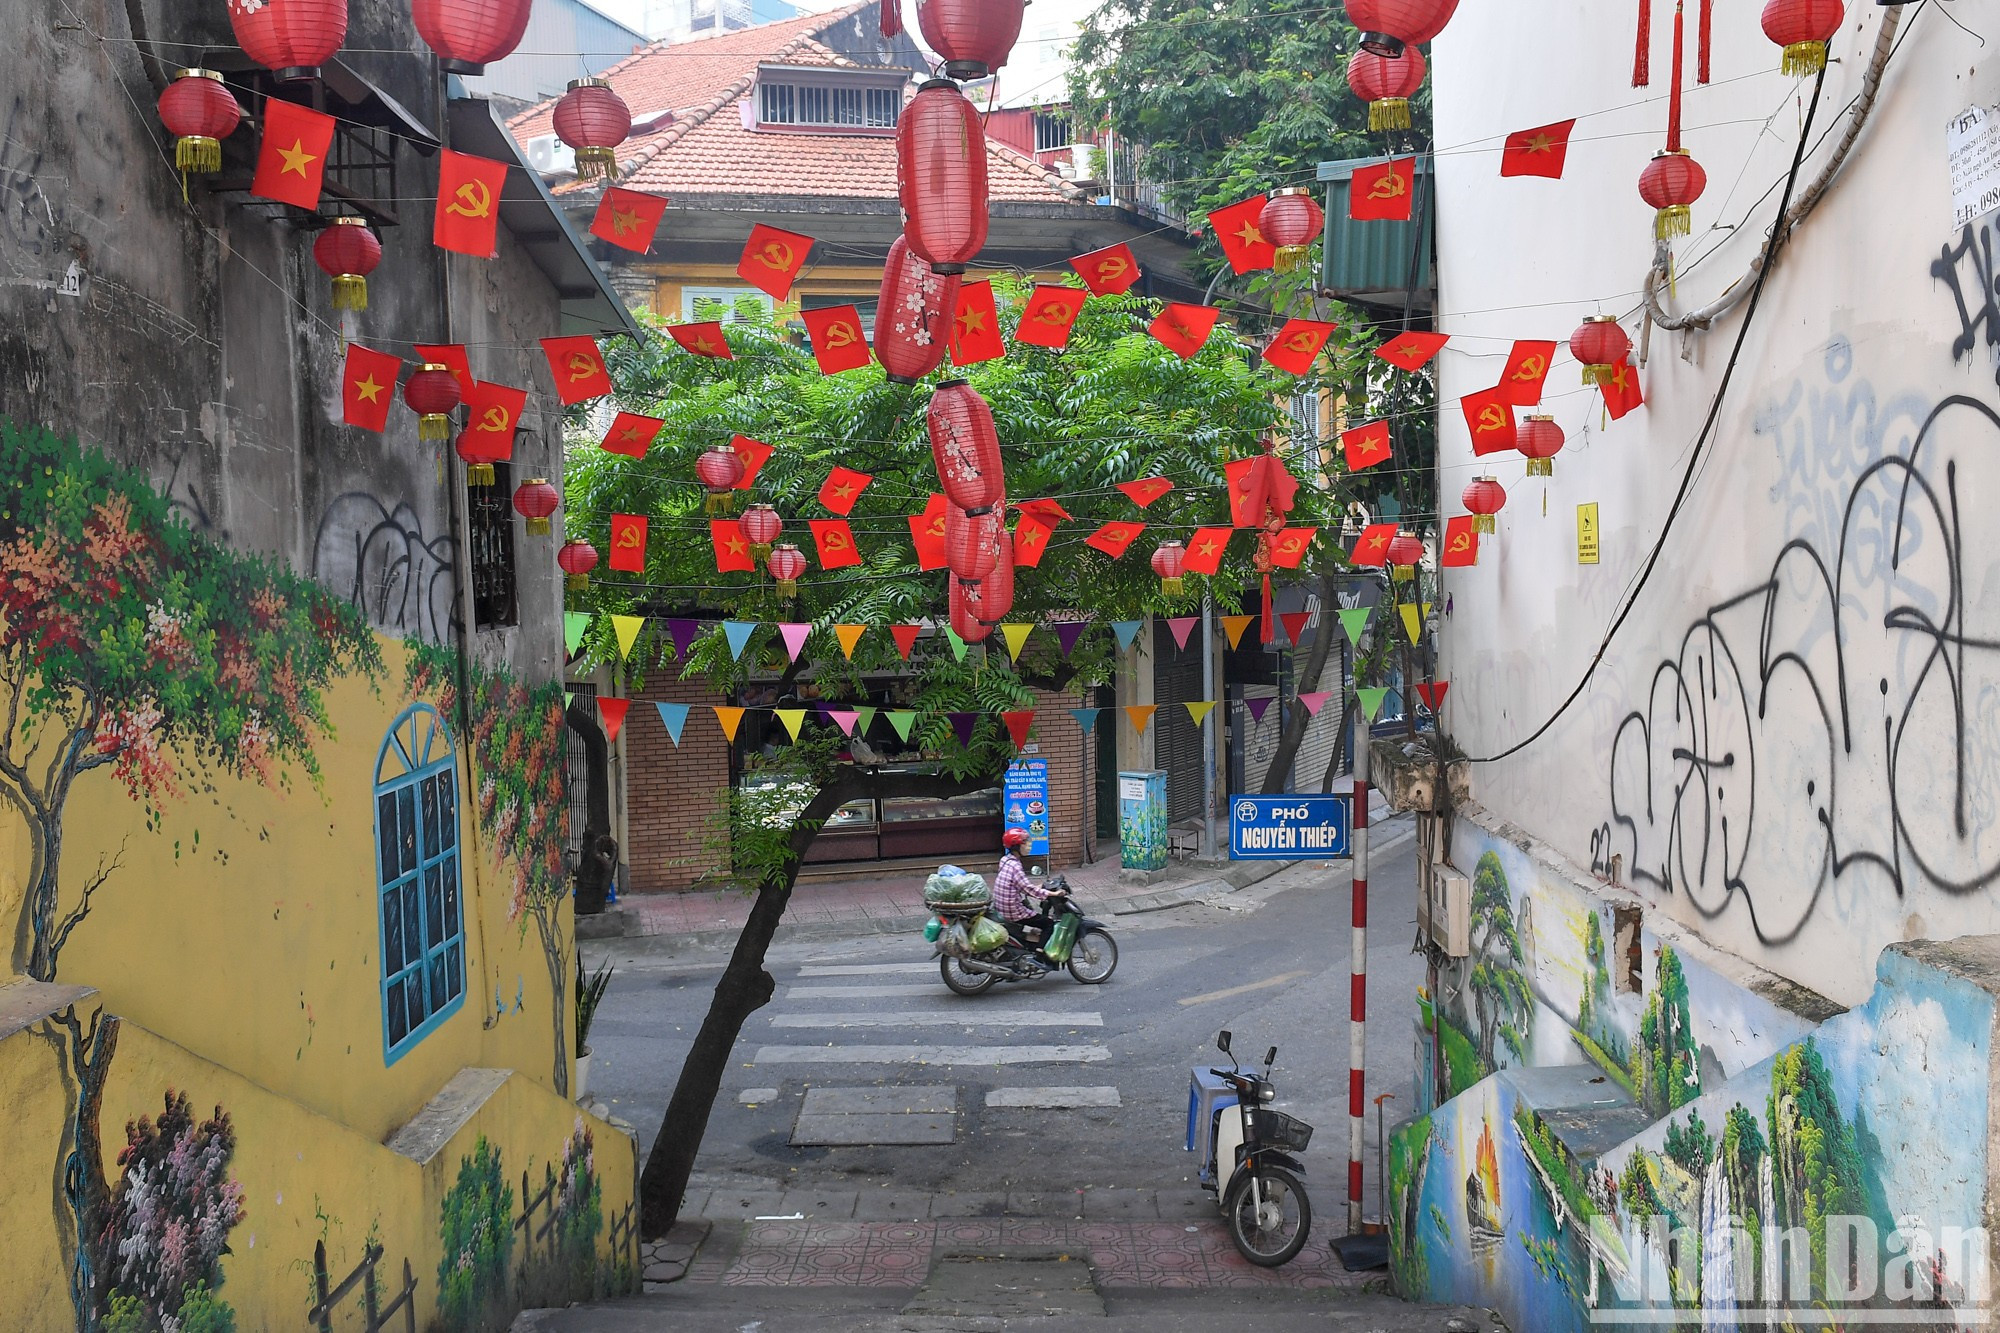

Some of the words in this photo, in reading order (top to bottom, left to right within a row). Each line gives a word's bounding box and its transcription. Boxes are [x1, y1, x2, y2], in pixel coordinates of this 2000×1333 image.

[1271, 803, 1310, 820] PHỐ
[1242, 820, 1296, 849] NGUYỄN
[1299, 820, 1337, 849] THIẾP
